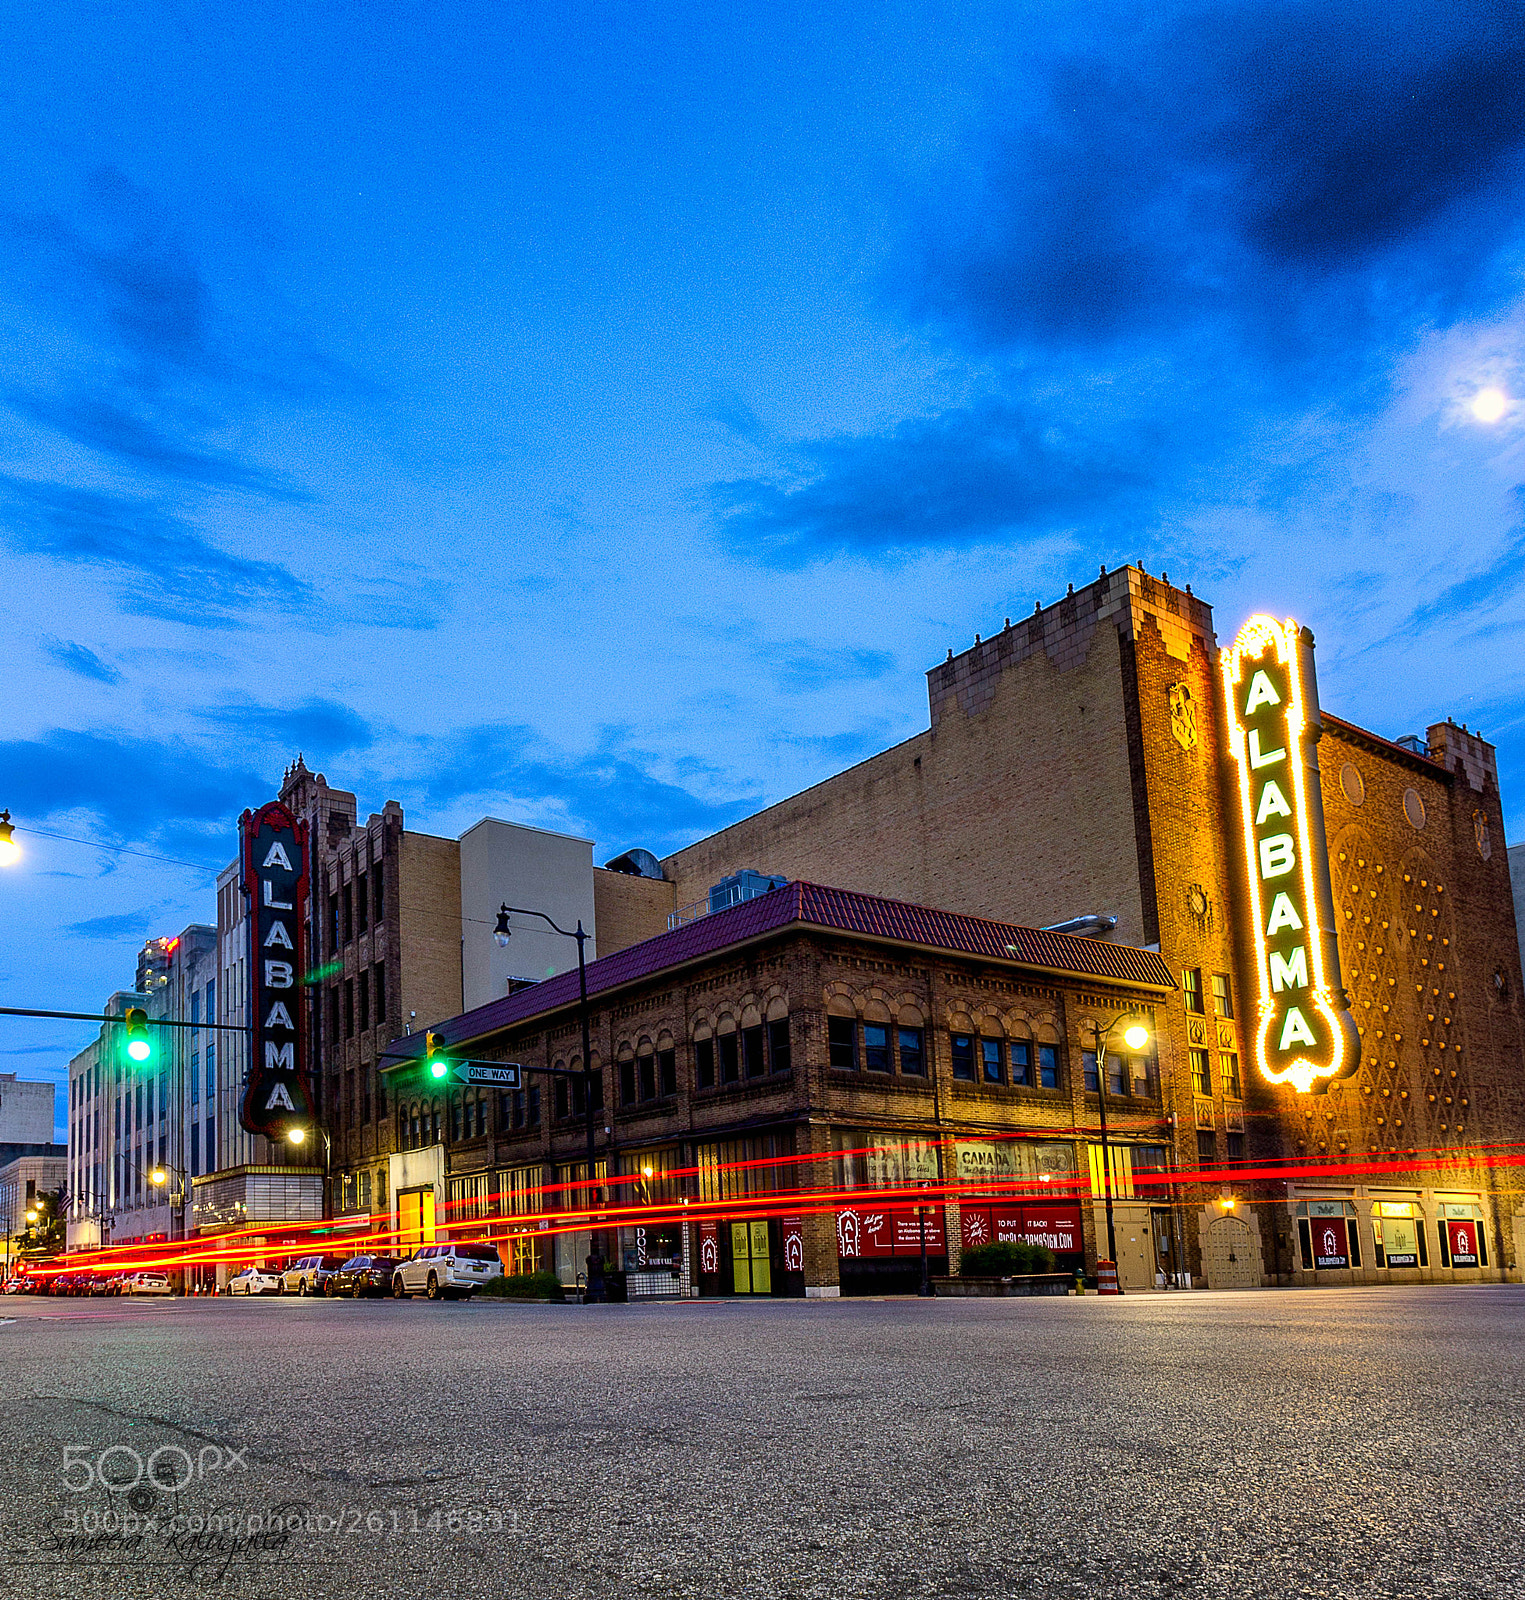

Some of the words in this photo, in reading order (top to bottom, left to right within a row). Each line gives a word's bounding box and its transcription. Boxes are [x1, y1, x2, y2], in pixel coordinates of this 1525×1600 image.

[262, 840, 296, 1111] ALABAMA
[1245, 670, 1317, 1051] ALABAMA
[468, 1067, 488, 1079] ONE
[491, 1069, 511, 1081] WAY
